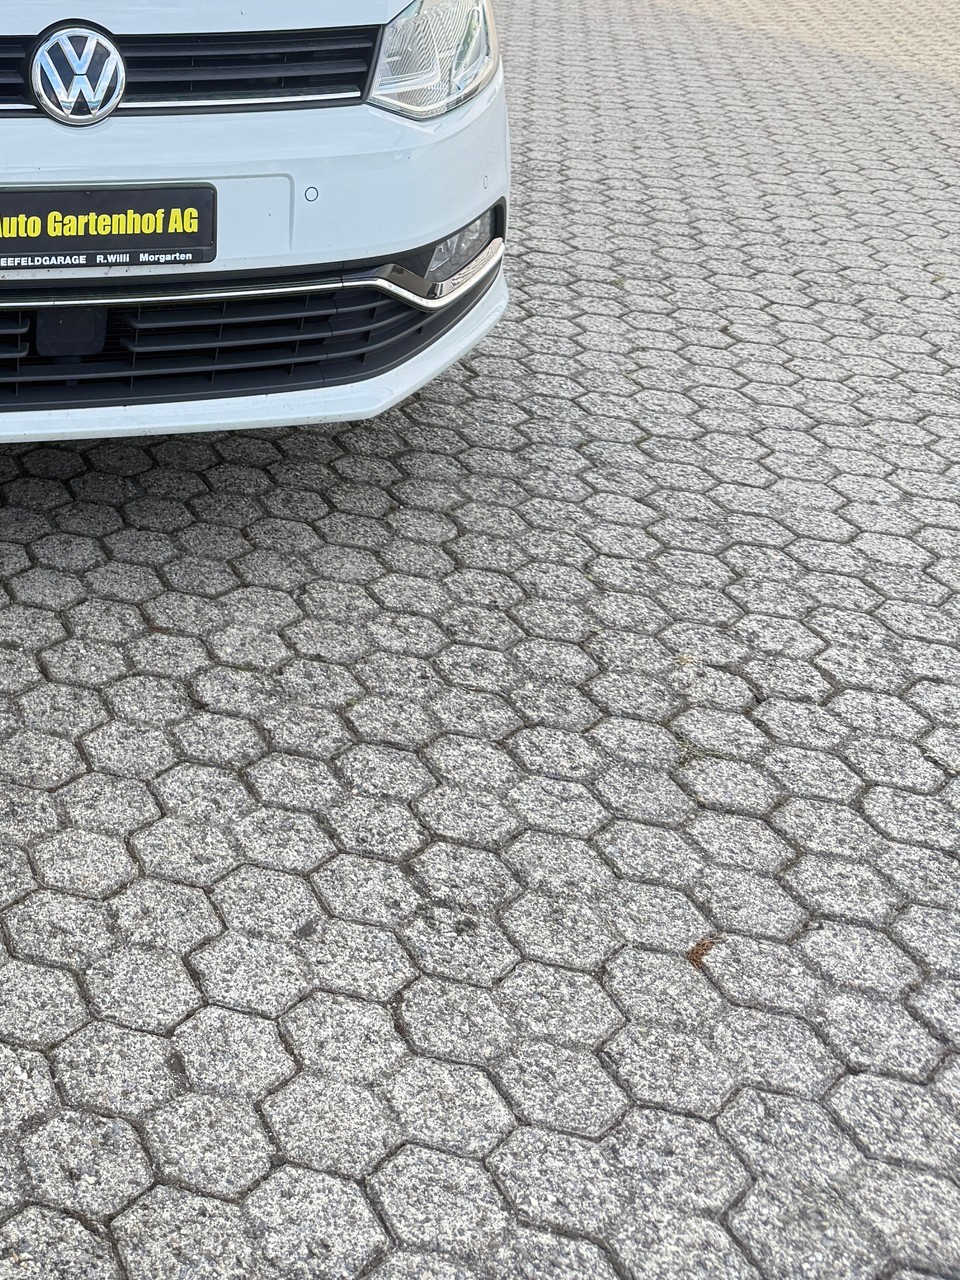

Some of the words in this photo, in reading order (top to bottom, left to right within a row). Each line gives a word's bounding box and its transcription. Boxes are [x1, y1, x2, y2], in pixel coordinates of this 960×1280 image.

[38, 32, 119, 118] VW
[47, 208, 165, 237] Gartenhof
[168, 207, 199, 233] AG
[96, 253, 130, 263] R.Willi
[139, 252, 193, 263] Morgarten
